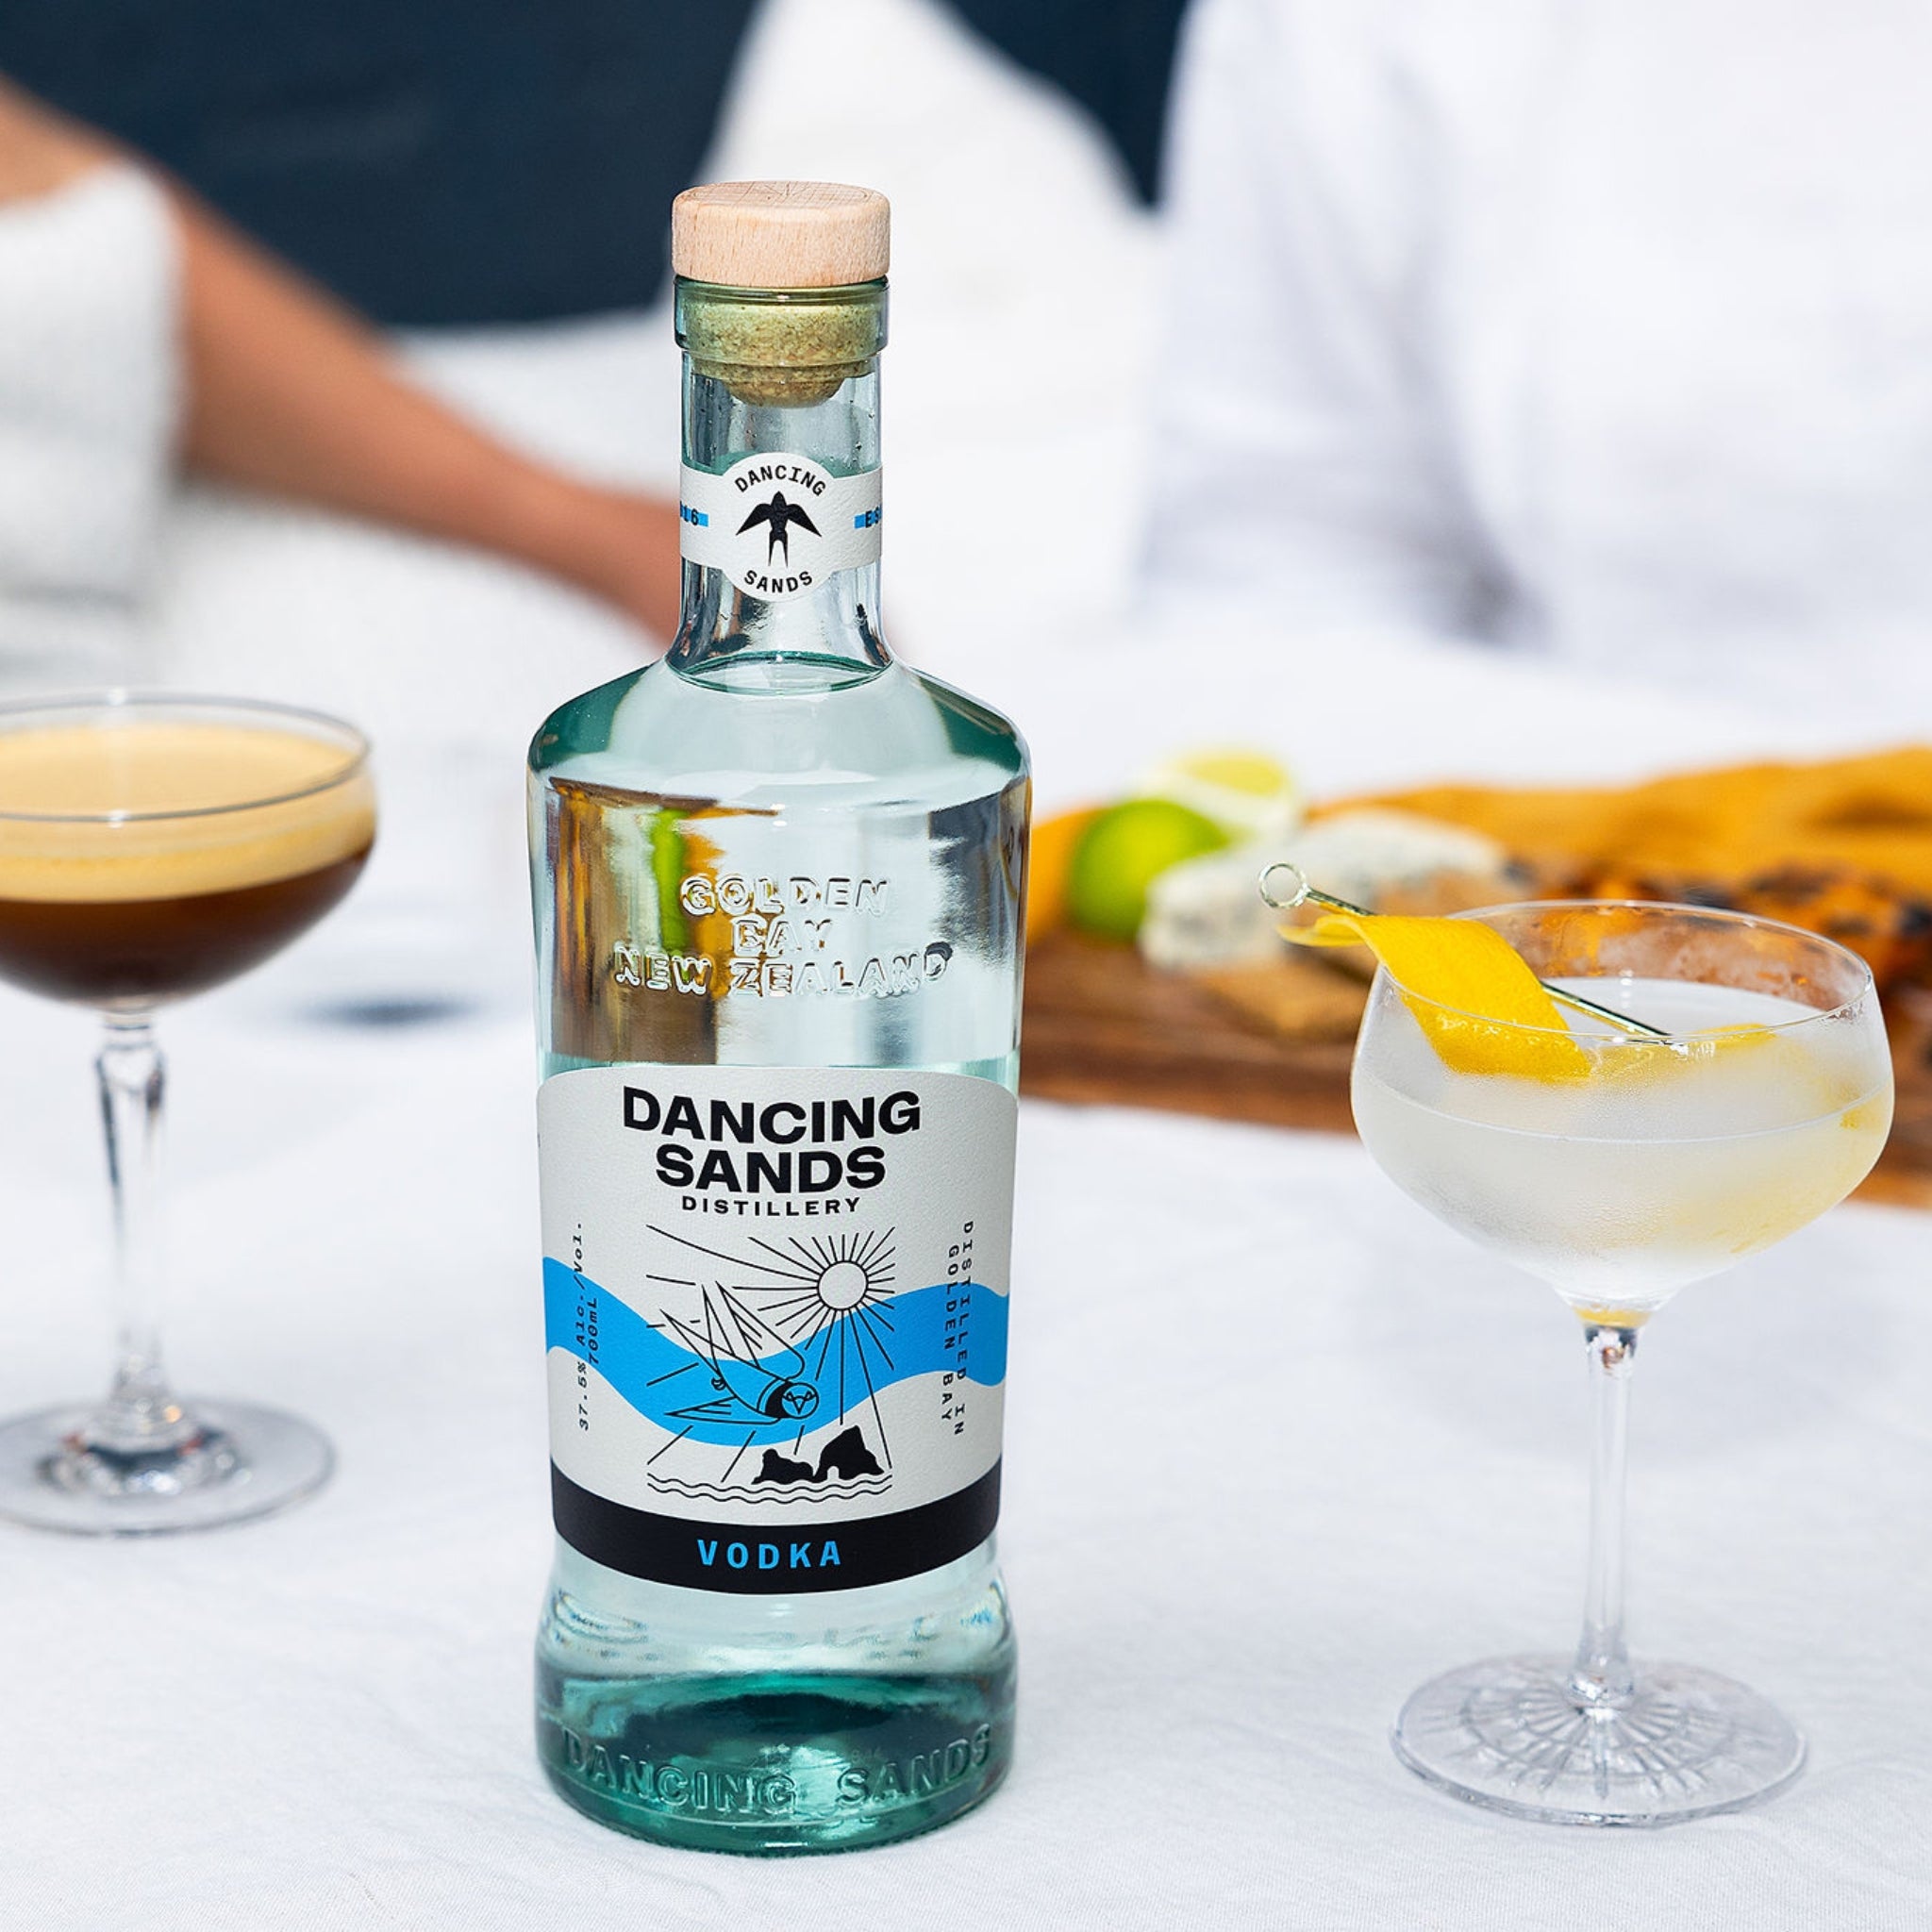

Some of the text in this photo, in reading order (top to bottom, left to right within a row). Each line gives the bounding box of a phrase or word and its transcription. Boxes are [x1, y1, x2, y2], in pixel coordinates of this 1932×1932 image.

[734, 465, 826, 496] DANCING
[743, 570, 813, 593] SANDS
[679, 874, 889, 916] GOLDEN
[732, 914, 833, 957] BAY
[613, 941, 954, 997] NEW ZEALAND
[624, 1086, 921, 1143] DANCING
[655, 1143, 886, 1193] SANDS
[681, 1195, 860, 1216] DISTILLERY
[587, 1298, 599, 1364] 700mL
[941, 1244, 959, 1420] GOLDEN BAY
[955, 1221, 974, 1435] DISTILLED IN
[577, 1361, 589, 1431] 37.5%
[697, 1539, 841, 1570] VODKA
[562, 1724, 991, 1813] DANCING SANDS
